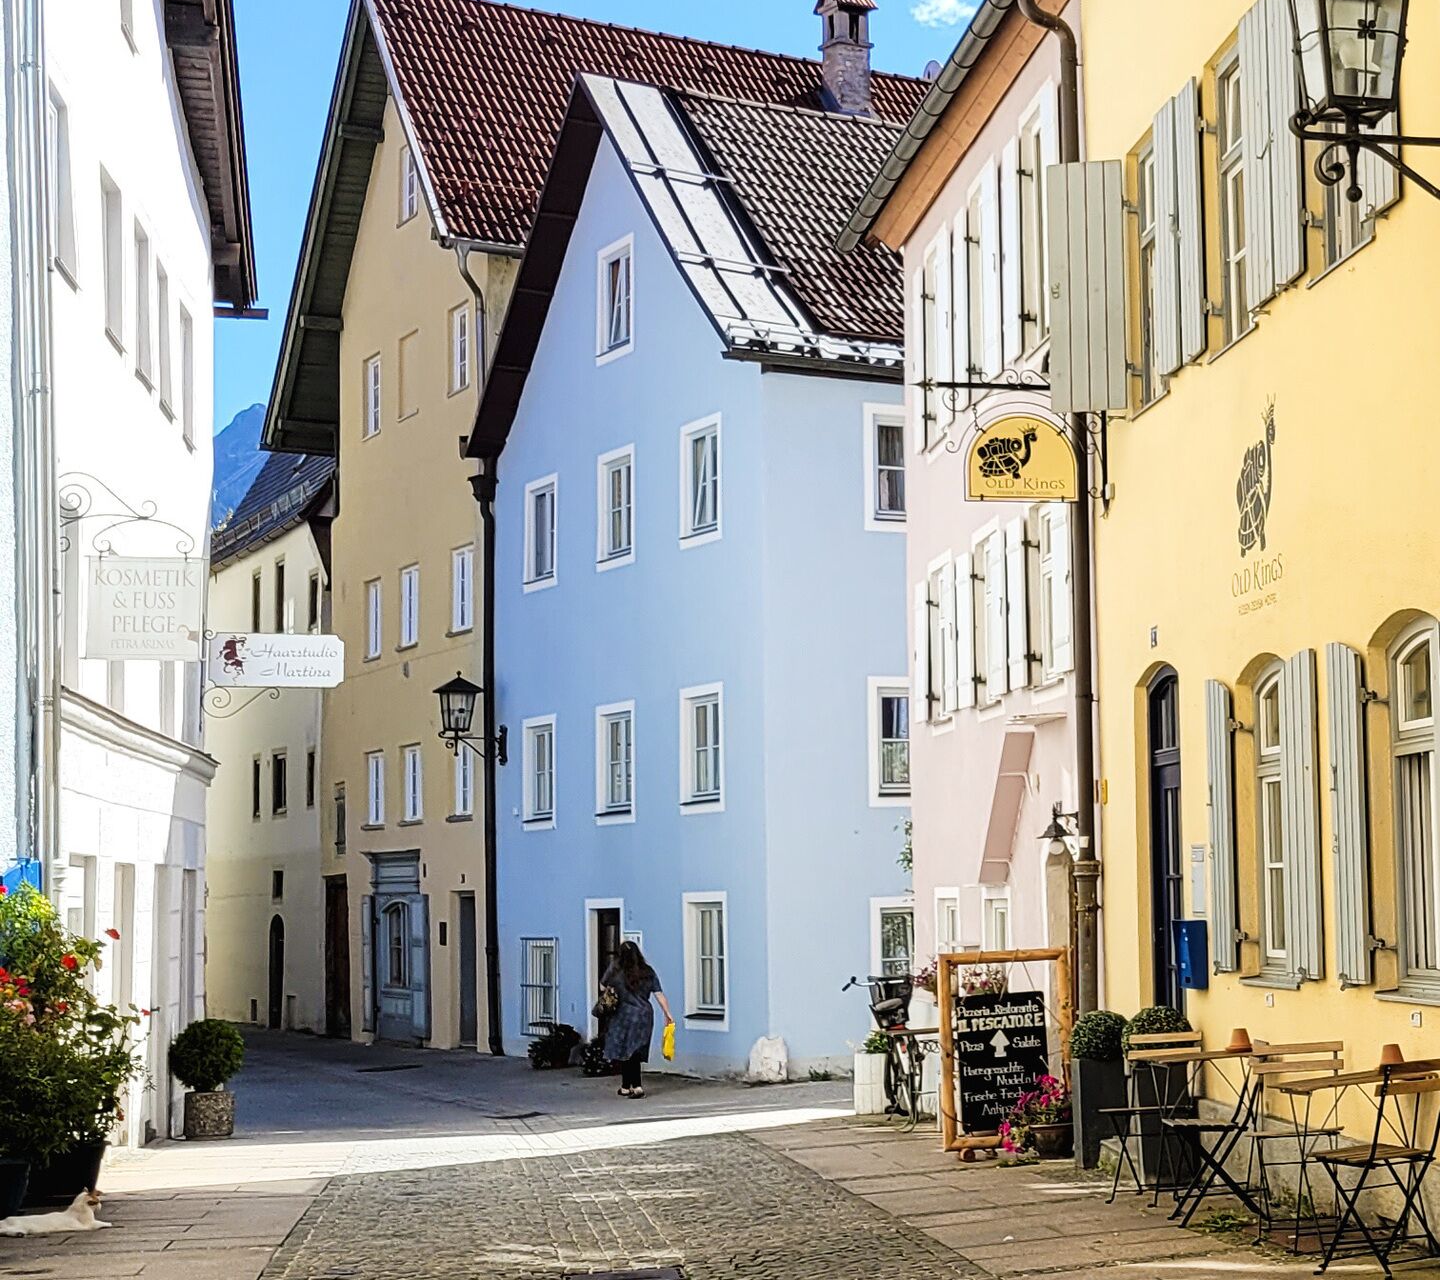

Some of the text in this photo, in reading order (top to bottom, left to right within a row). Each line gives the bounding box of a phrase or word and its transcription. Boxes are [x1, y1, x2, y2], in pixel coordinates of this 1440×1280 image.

[94, 568, 196, 588] KOSMETIK
[112, 590, 176, 610] & FUSS
[111, 615, 176, 634] PFLEGE
[250, 642, 339, 659] Haarstudio
[259, 662, 332, 678] Martina
[956, 1005, 990, 1018] Pizzeria
[957, 1012, 1044, 1033] IL PESCATORE
[960, 1035, 1042, 1052] Pizza Salate
[963, 1090, 998, 1103] Frische
